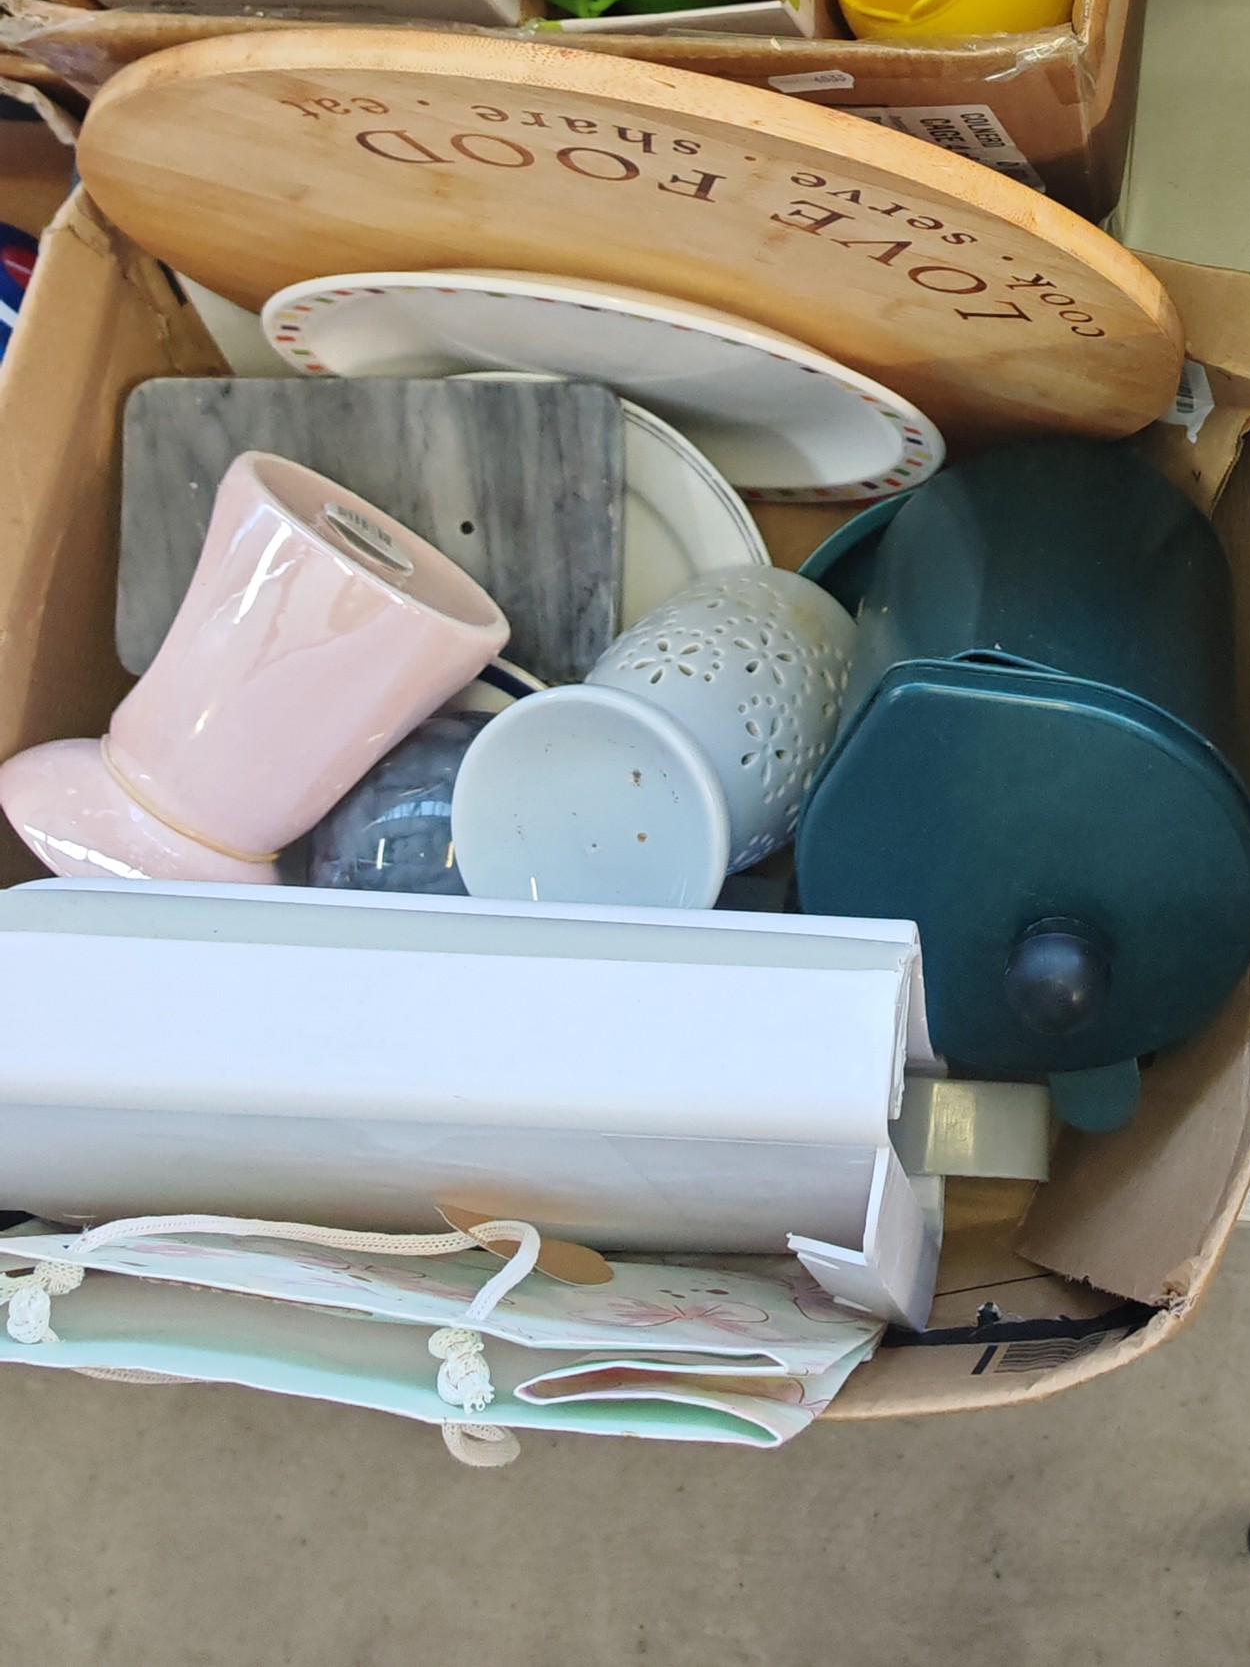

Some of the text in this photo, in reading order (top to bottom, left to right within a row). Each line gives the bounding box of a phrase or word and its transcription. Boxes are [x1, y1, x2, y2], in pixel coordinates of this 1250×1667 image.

[279, 96, 1106, 338] cook serve share eat
[356, 129, 1033, 323] LOVE FOOD
[920, 118, 966, 150] CAGE
